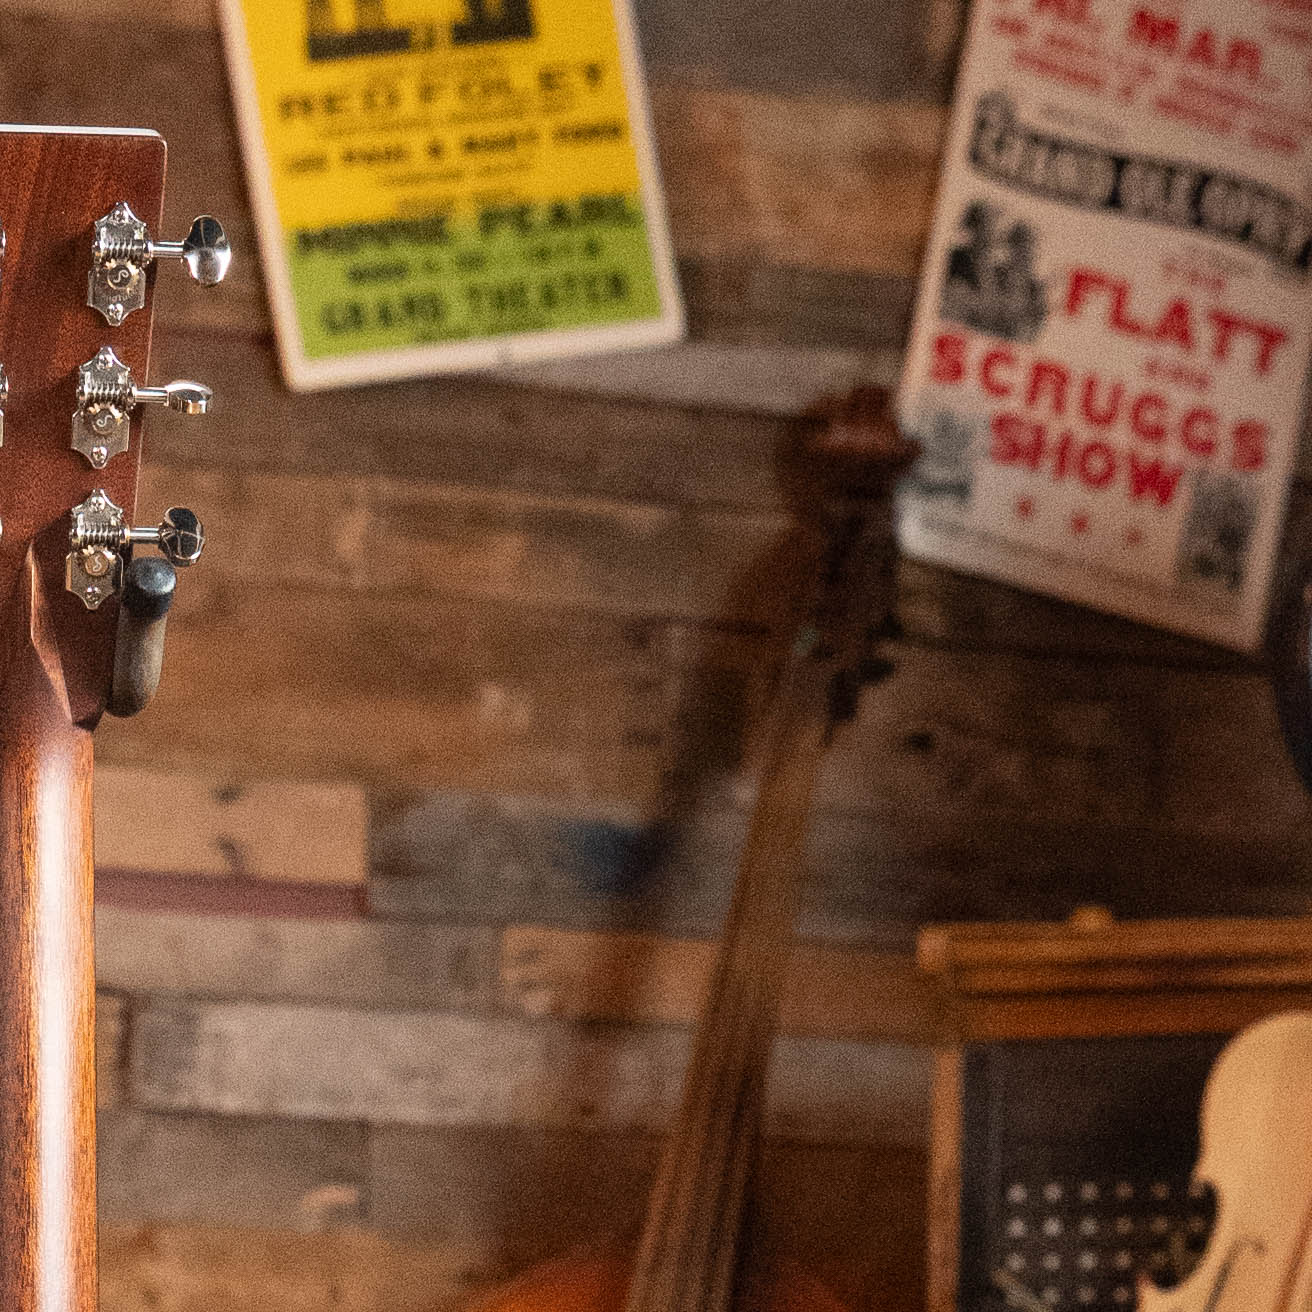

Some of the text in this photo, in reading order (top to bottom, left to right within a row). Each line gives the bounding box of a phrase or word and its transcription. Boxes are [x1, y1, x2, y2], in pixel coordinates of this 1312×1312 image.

[1064, 264, 1290, 375] FLATT
[927, 330, 1271, 473] SCRUGGS
[988, 410, 1185, 508] SHOW
